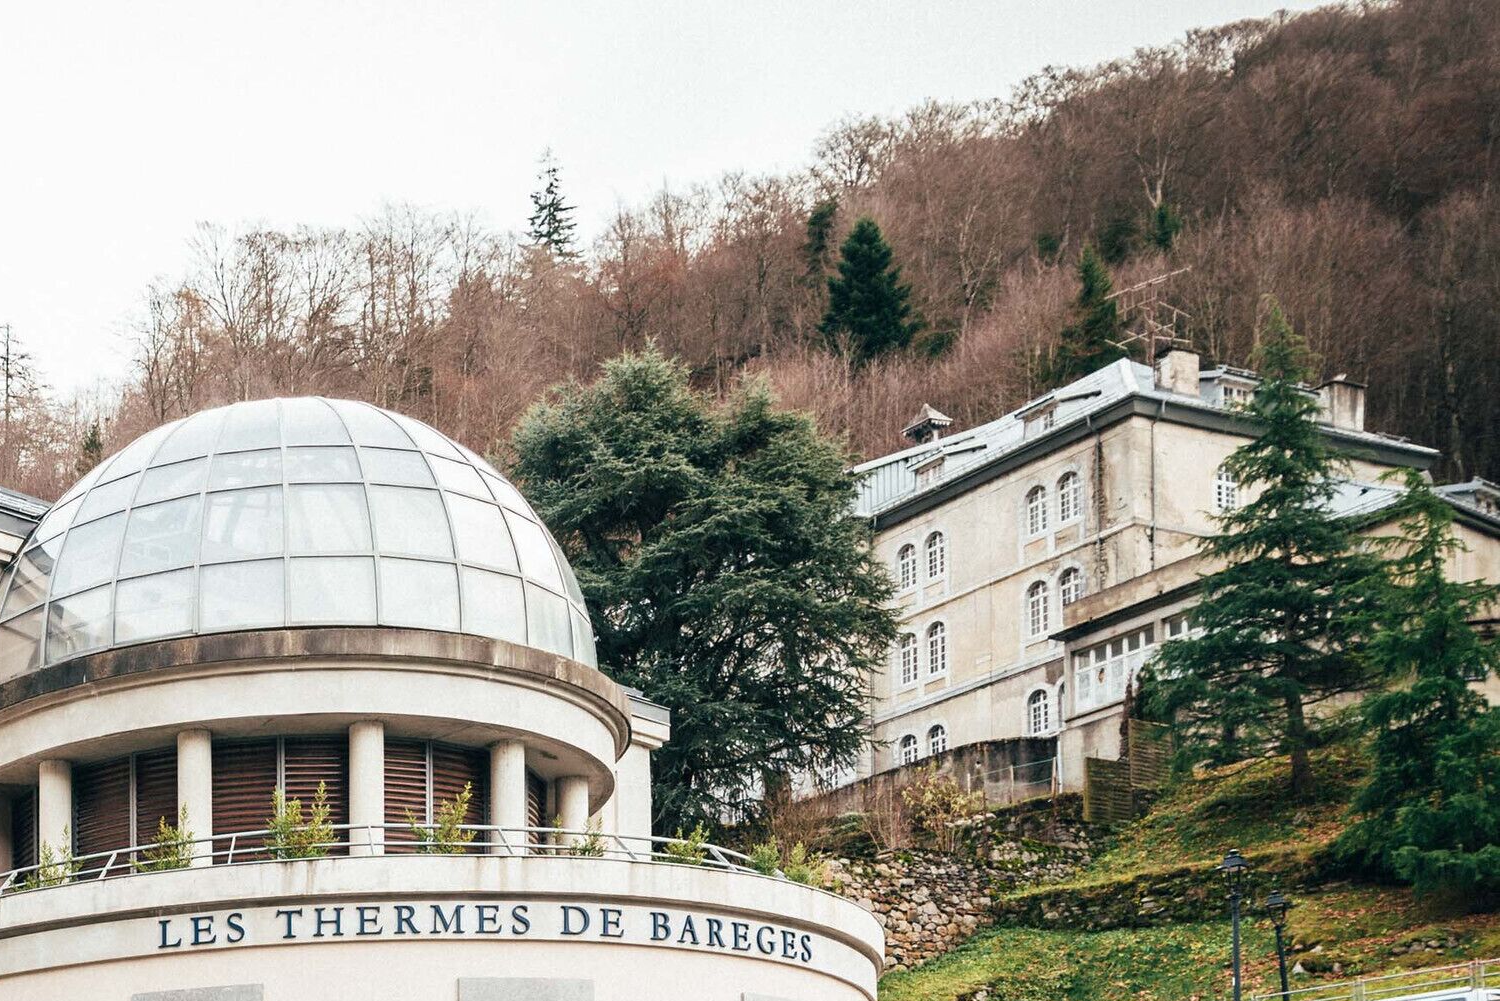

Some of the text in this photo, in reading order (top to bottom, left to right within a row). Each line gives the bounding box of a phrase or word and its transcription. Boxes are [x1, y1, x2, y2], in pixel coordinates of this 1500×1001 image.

[157, 904, 813, 963] LES THERMES DE BAREGES
